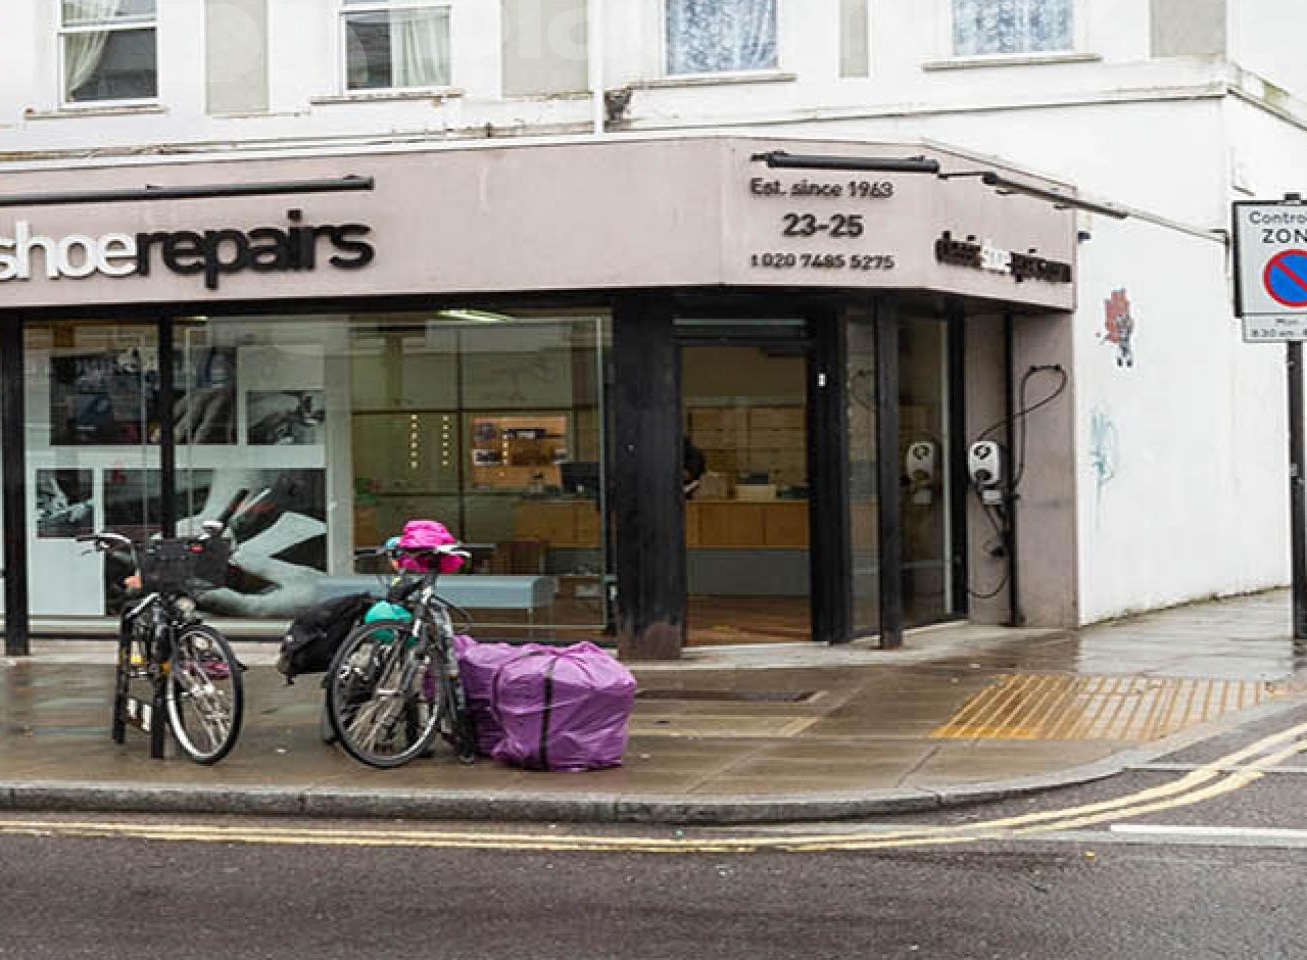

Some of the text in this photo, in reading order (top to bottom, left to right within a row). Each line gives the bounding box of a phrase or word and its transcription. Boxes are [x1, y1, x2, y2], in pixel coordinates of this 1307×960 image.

[791, 179, 843, 196] since
[847, 181, 894, 198] 1963
[782, 213, 865, 238] 23-25
[761, 252, 796, 268] 020
